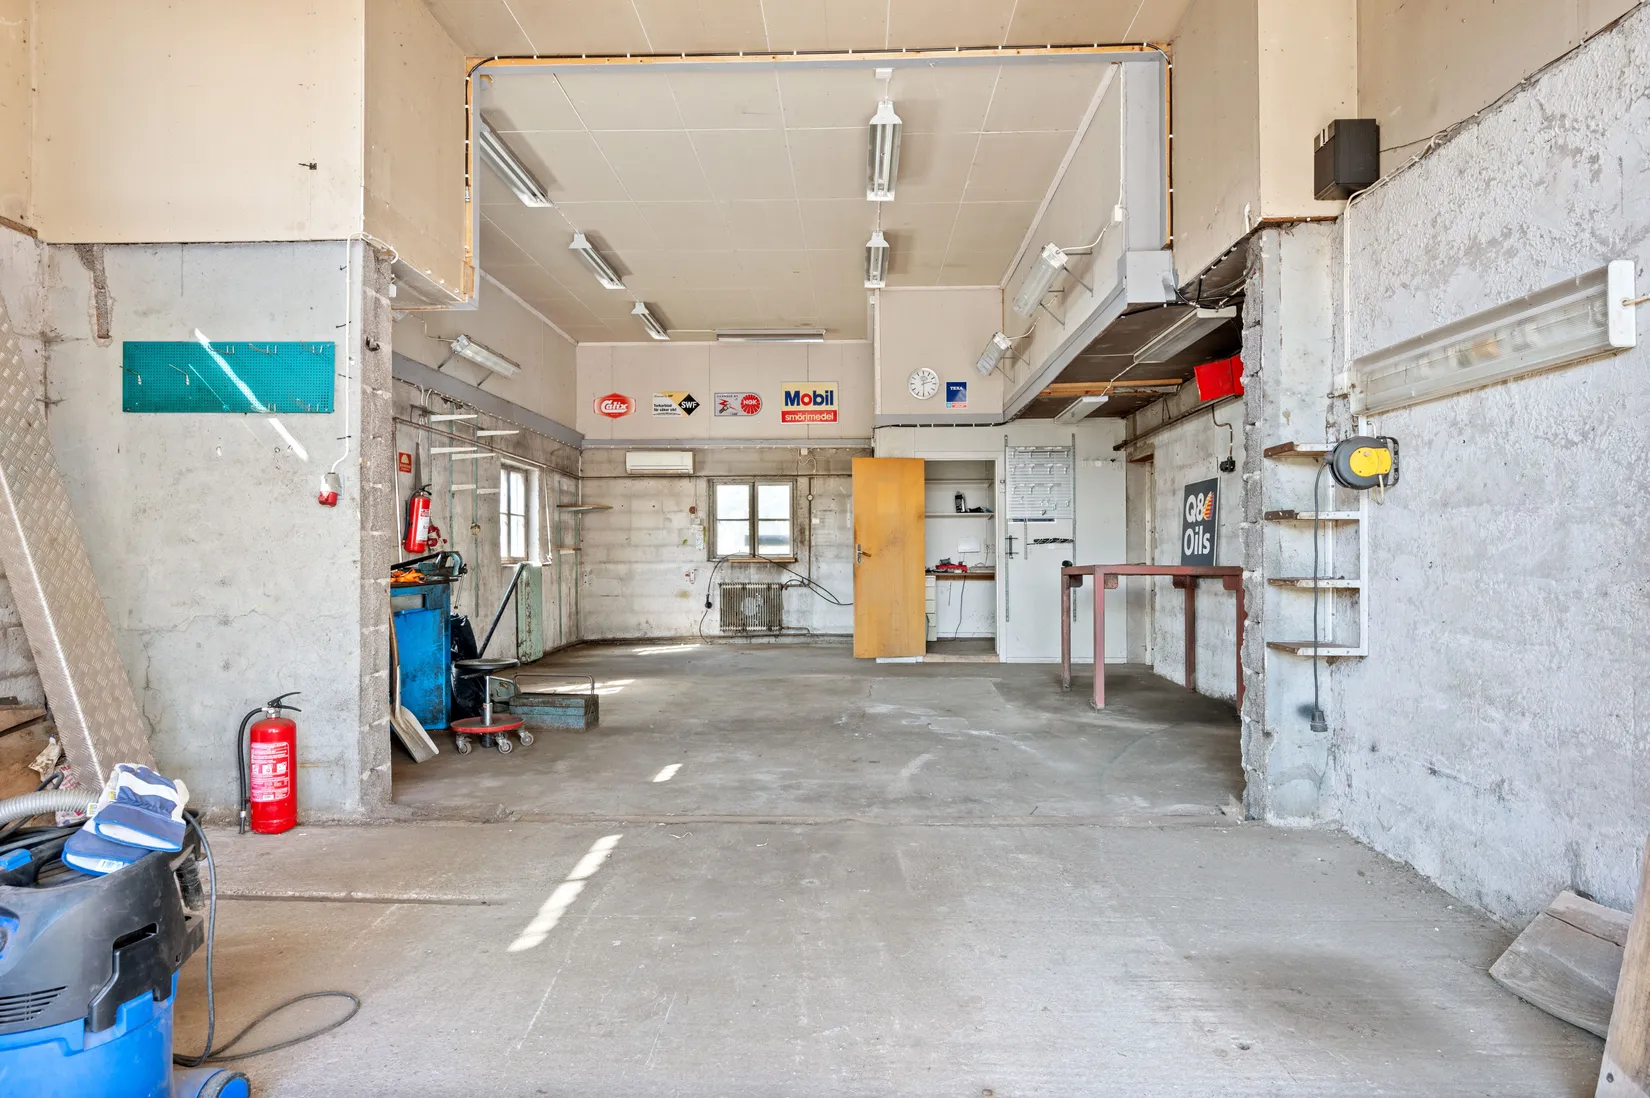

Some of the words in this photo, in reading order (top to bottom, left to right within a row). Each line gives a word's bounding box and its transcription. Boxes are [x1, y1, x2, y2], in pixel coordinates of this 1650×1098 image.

[601, 399, 629, 413] Calix
[680, 400, 698, 409] SWF
[784, 390, 834, 407] Mobil
[784, 412, 834, 422] smörjmedel
[1185, 492, 1205, 523] Q8
[1183, 525, 1211, 556] Oils
